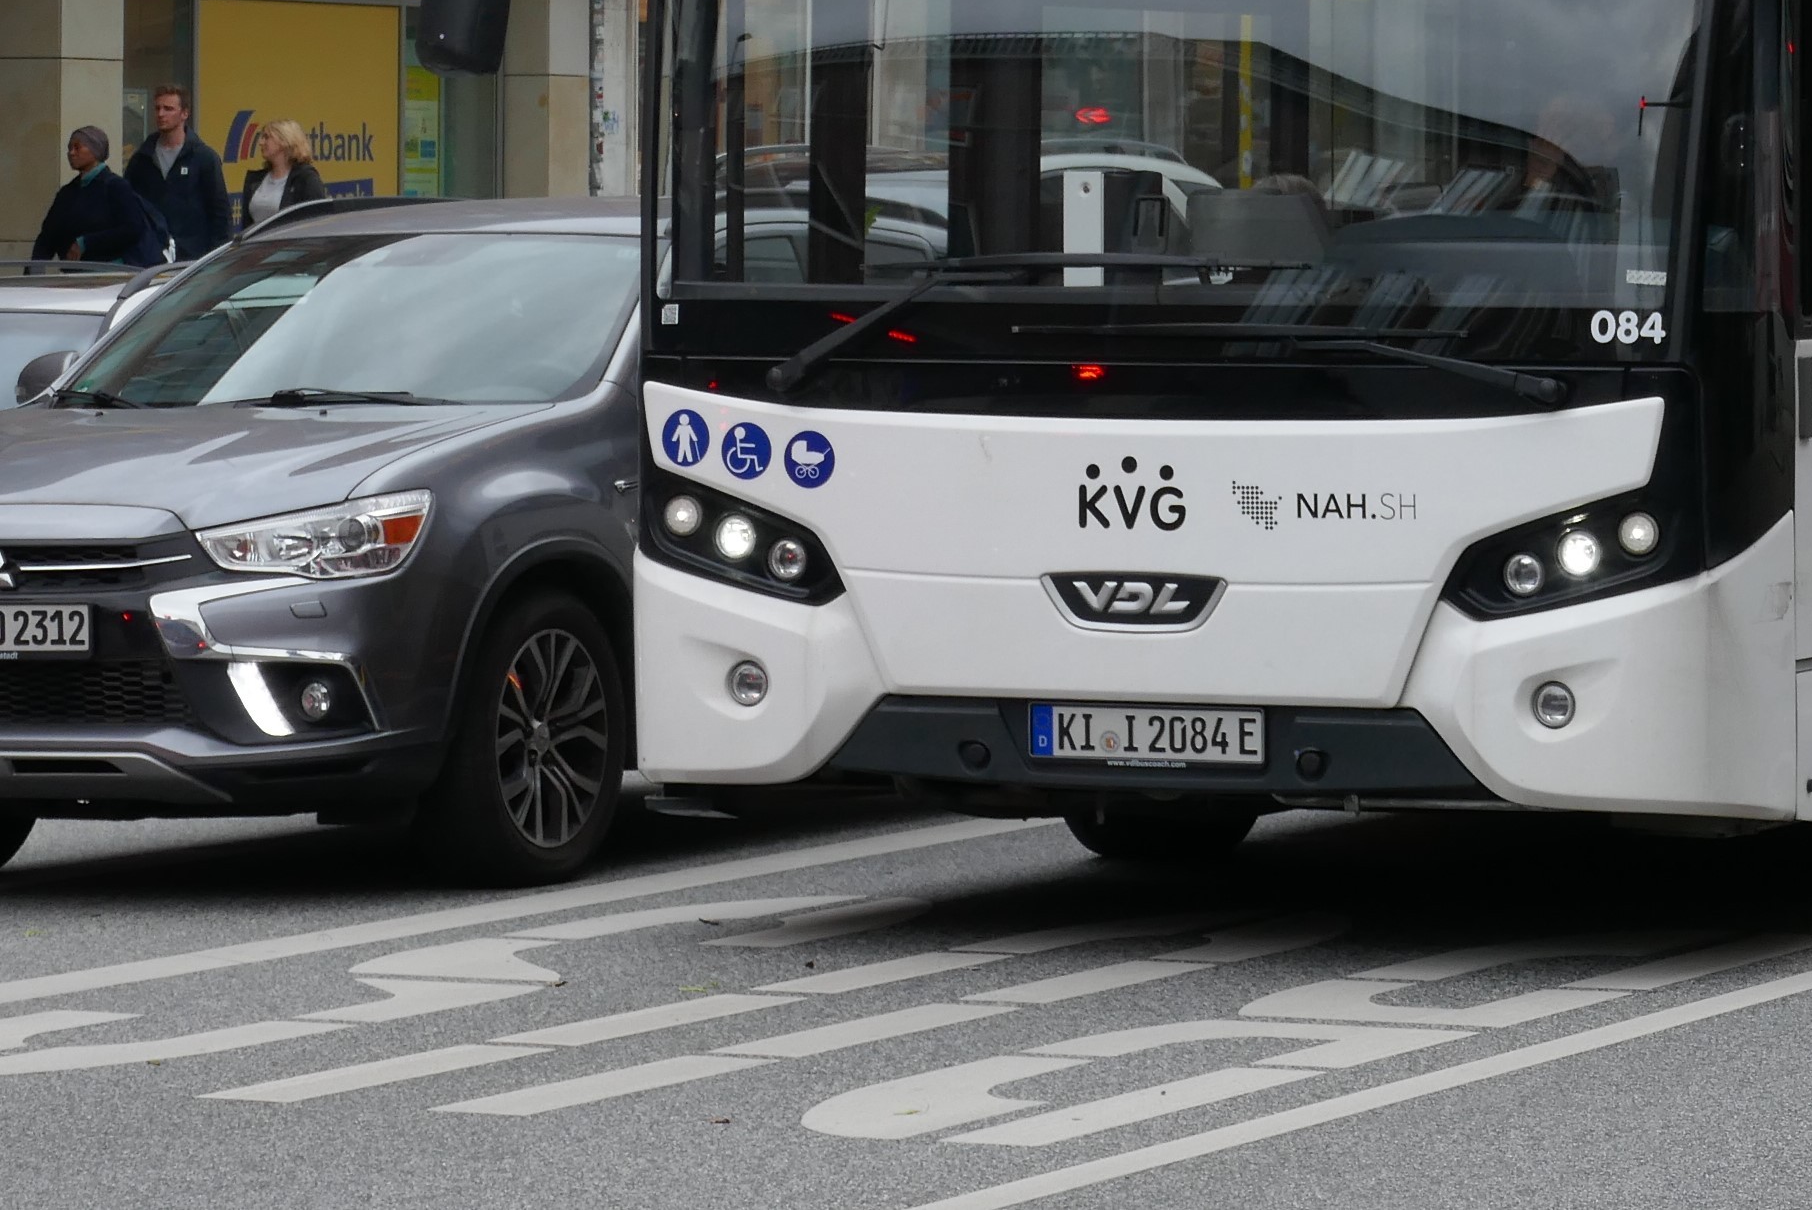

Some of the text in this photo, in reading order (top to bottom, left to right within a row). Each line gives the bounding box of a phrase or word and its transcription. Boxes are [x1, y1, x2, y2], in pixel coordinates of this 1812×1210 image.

[309, 121, 374, 162] tbank
[1590, 309, 1667, 345] 084
[1078, 483, 1187, 532] KVG
[1296, 492, 1417, 521] NAH.SH
[1072, 580, 1191, 614] VDL
[13, 610, 86, 646] 2312
[1057, 712, 1096, 752] KI
